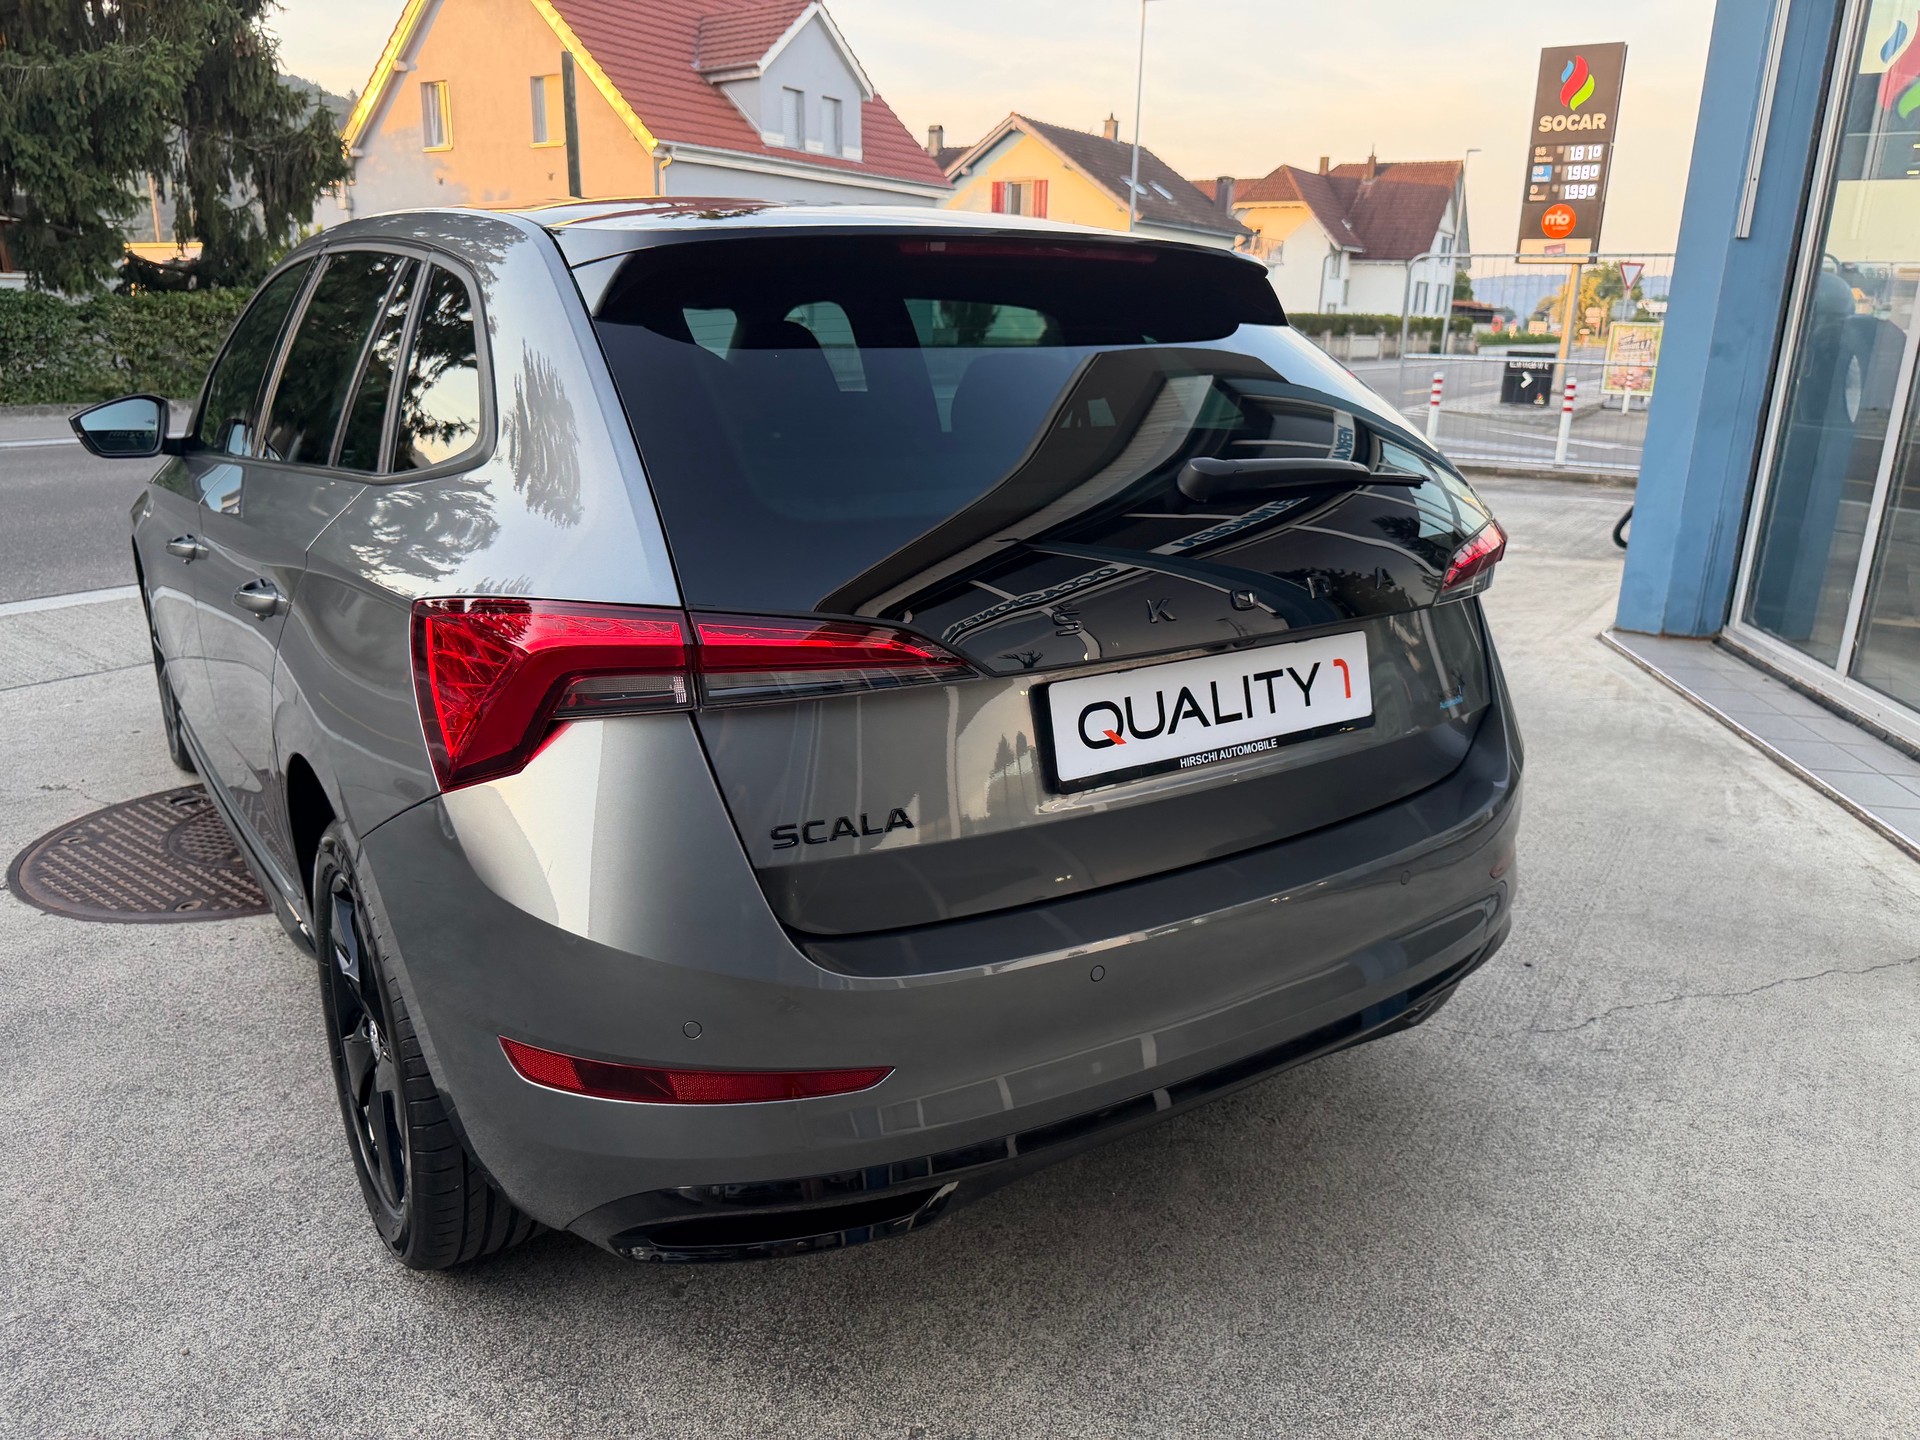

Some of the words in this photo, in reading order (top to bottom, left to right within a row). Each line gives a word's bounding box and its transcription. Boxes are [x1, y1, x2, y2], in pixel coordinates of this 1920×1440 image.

[1538, 113, 1607, 133] SOCAR
[1179, 751, 1219, 770] HIRSCHI
[1218, 738, 1279, 762] AUTOMOBILE
[770, 807, 915, 850] SCALA
